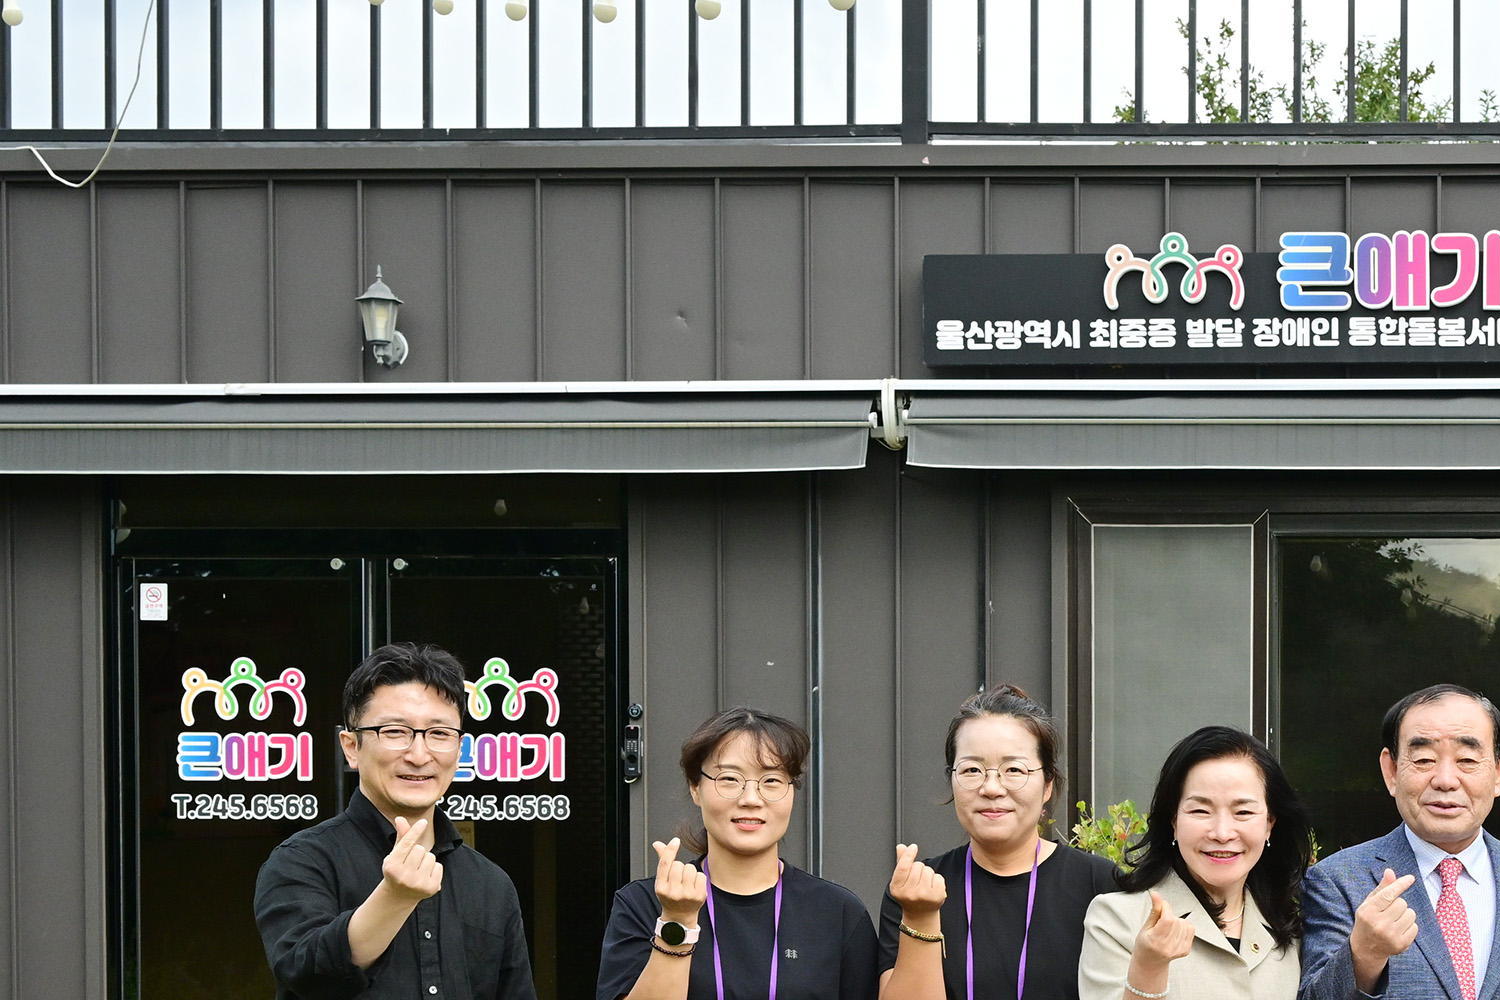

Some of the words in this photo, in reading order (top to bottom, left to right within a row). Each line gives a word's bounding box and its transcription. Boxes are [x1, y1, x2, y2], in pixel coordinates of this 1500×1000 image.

[935, 319, 1081, 350] 울산광역시
[1089, 317, 1177, 348] 최중증
[1185, 317, 1245, 348] 발달
[1252, 316, 1340, 348] 장애인
[176, 732, 314, 781] 큰애기
[171, 794, 318, 820] T.245.6568
[440, 794, 571, 821] 245.6568
